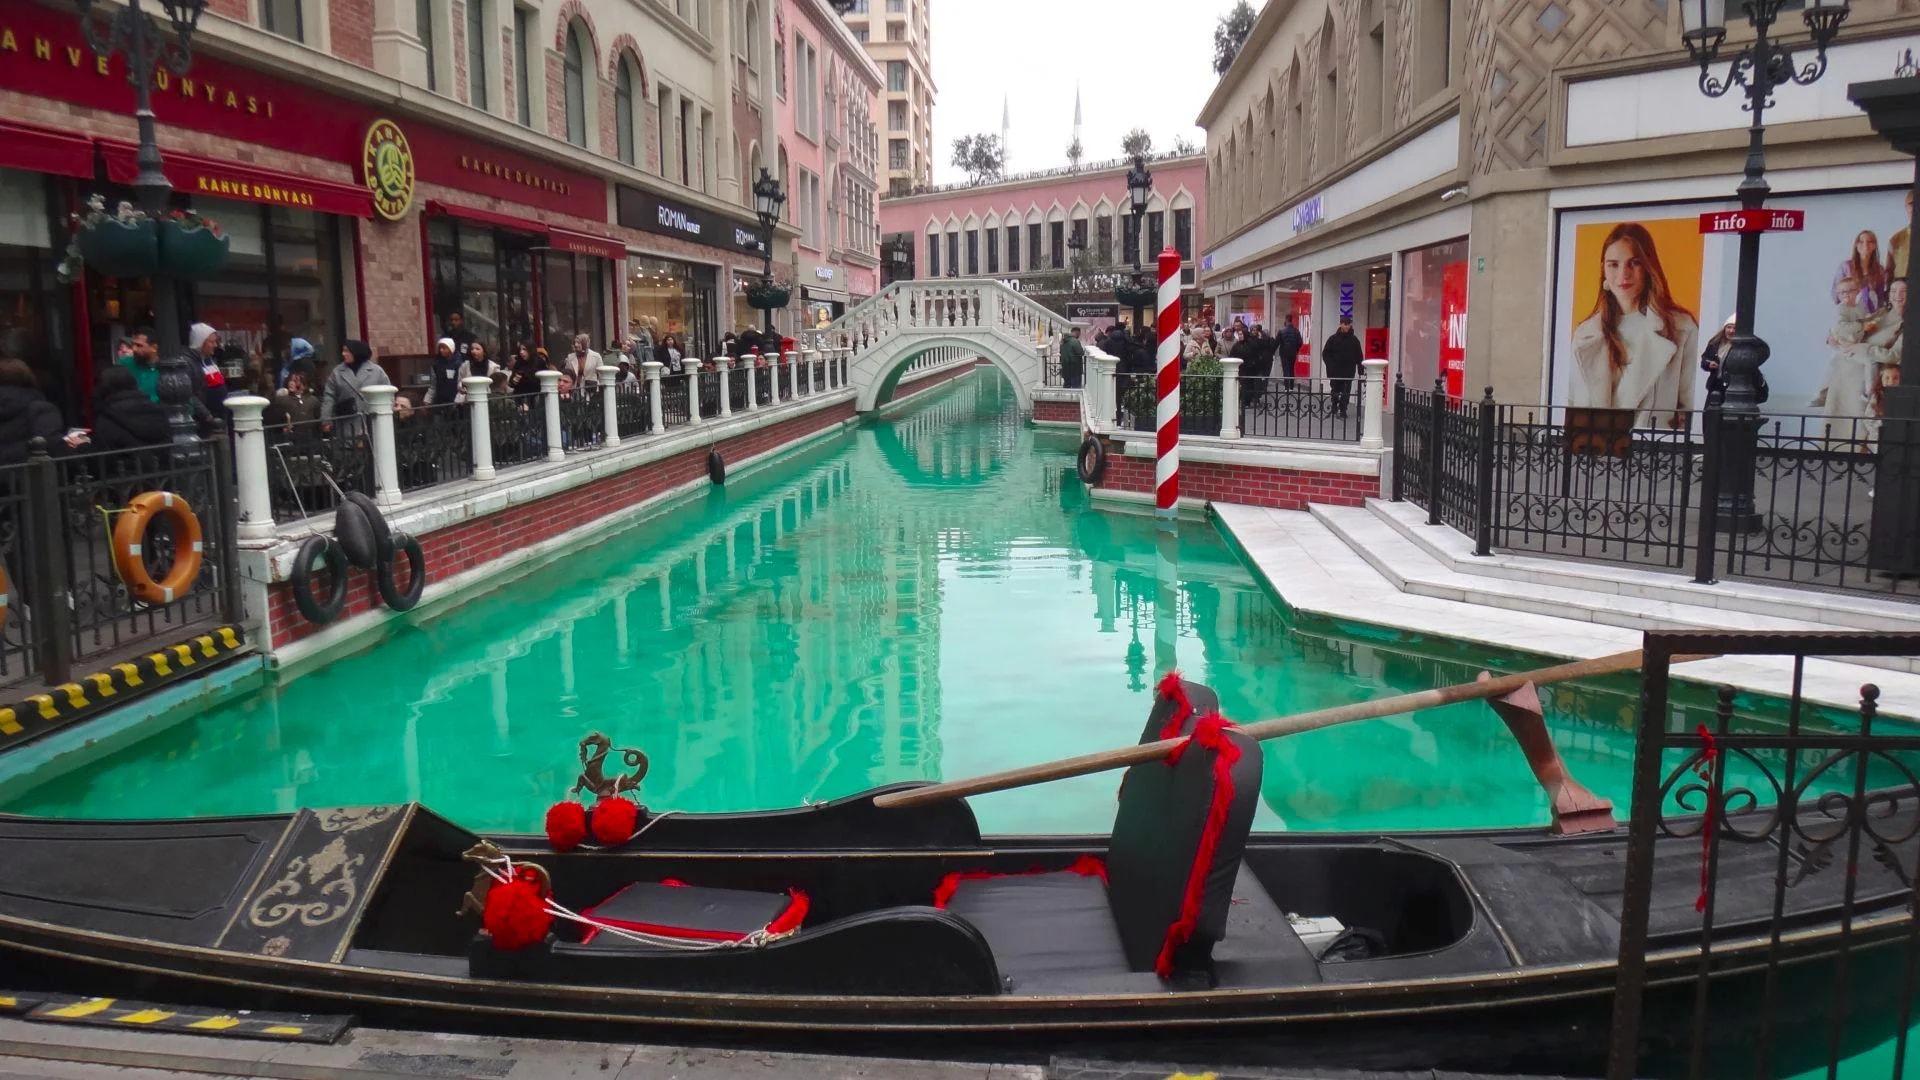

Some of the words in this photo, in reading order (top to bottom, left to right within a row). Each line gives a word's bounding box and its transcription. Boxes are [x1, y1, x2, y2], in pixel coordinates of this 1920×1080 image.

[127, 66, 274, 118] ÜNYASI
[461, 156, 510, 180] KAHVE
[199, 177, 249, 197] KAHVE
[253, 185, 313, 205] DÜNYASI
[658, 206, 687, 230] ROMAN
[1713, 214, 1746, 230] info
[1771, 212, 1795, 228] info
